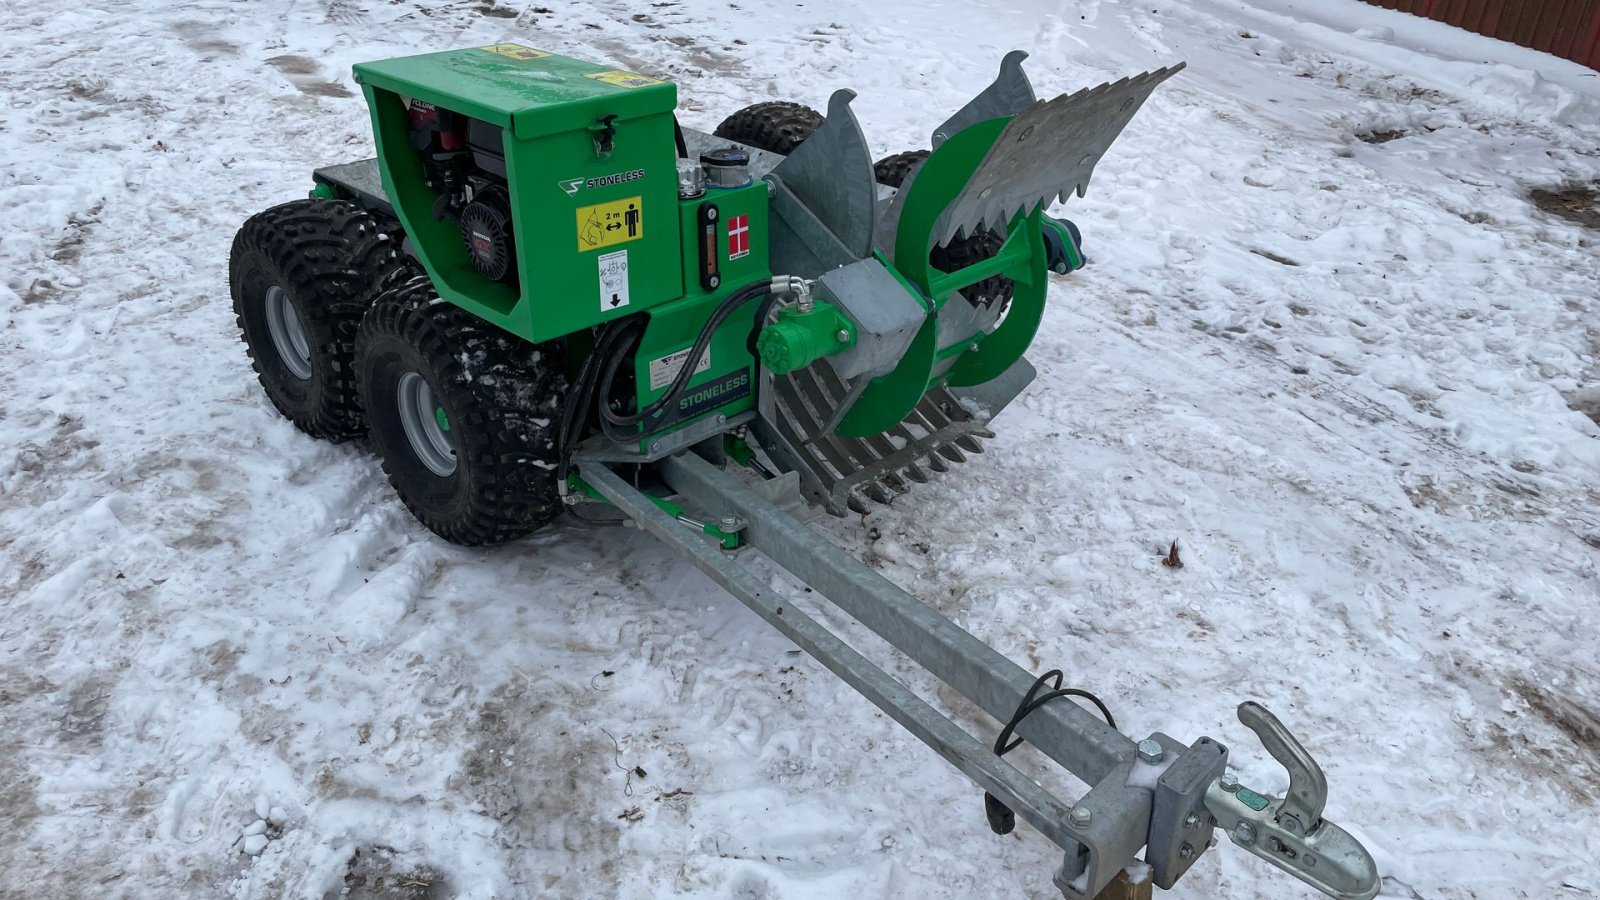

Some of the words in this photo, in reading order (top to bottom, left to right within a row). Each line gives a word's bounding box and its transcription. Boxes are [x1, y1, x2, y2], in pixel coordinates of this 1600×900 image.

[587, 169, 645, 190] STONELESS
[606, 212, 611, 220] 2
[473, 231, 491, 242] HONDA
[680, 374, 748, 410] STONELESS
